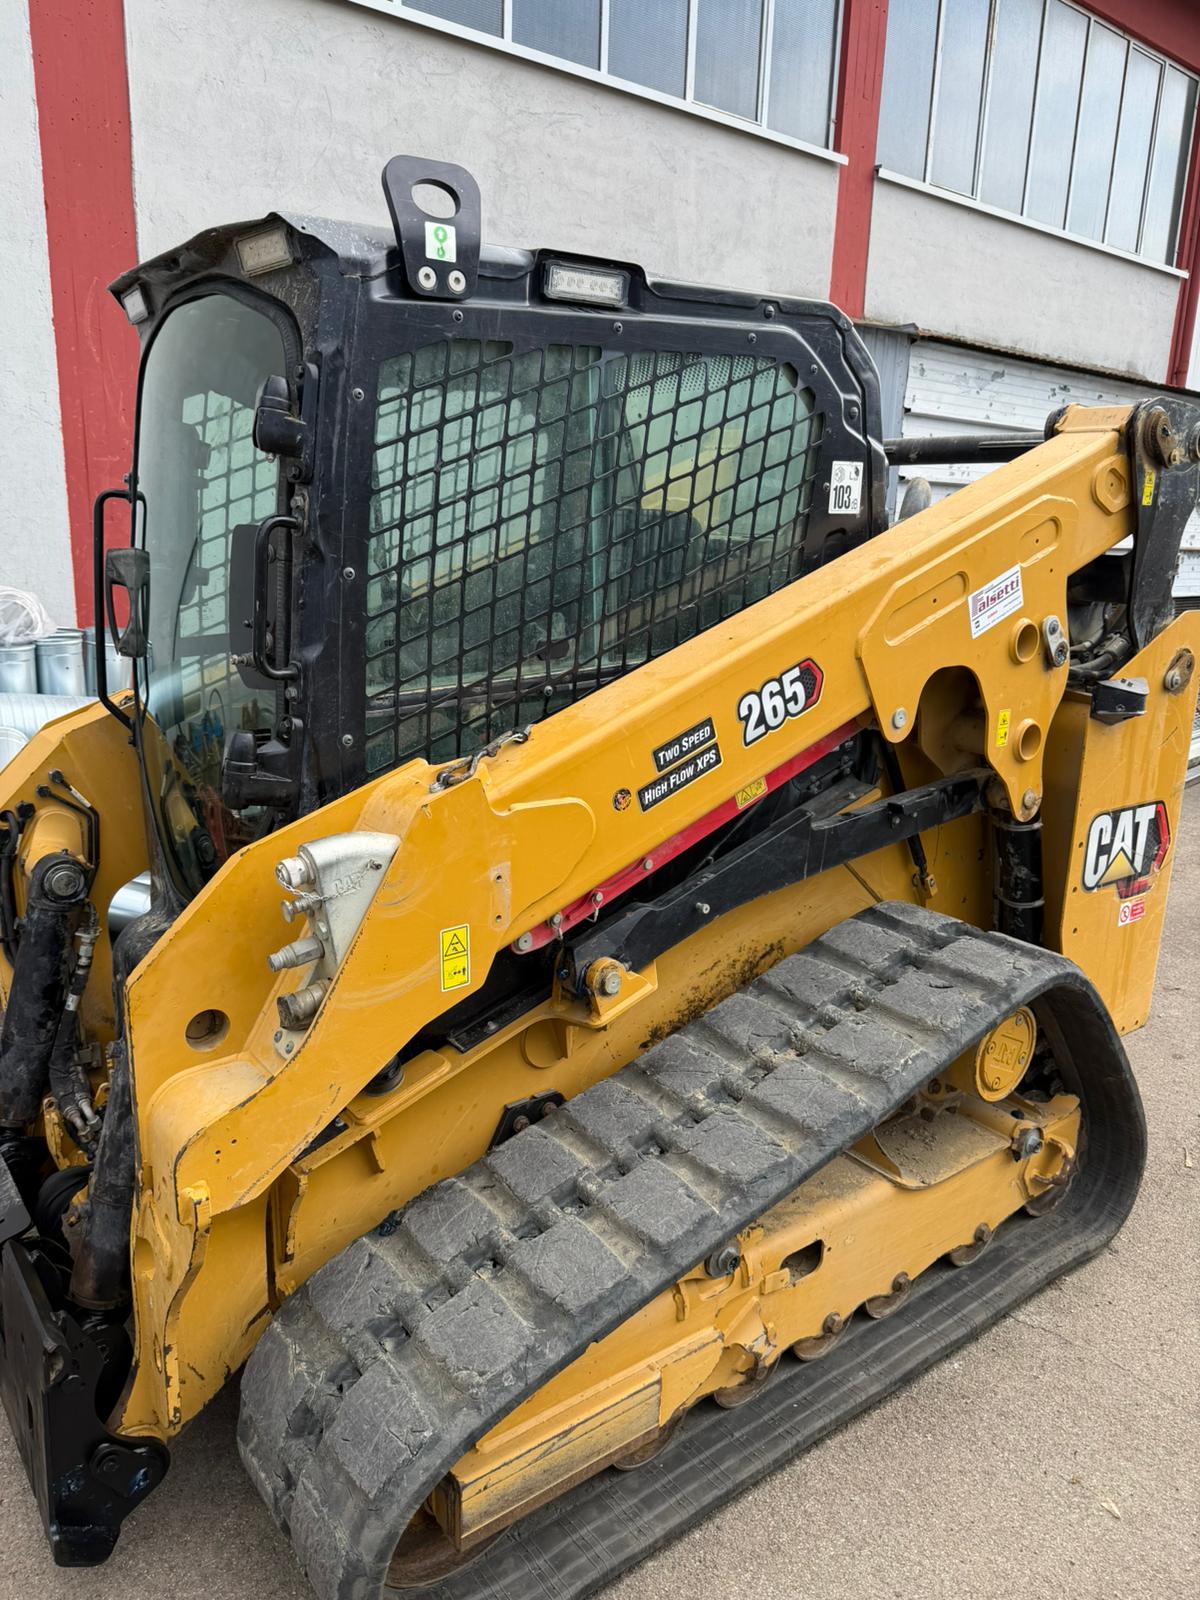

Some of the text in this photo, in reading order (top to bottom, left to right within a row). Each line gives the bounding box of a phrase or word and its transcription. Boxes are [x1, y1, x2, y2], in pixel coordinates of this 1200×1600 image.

[833, 485, 851, 509] 103
[739, 666, 806, 743] 265
[658, 726, 711, 765] TWO SPEED
[644, 750, 717, 804] HIGH FLOW XPS
[1083, 804, 1157, 888] CAT
